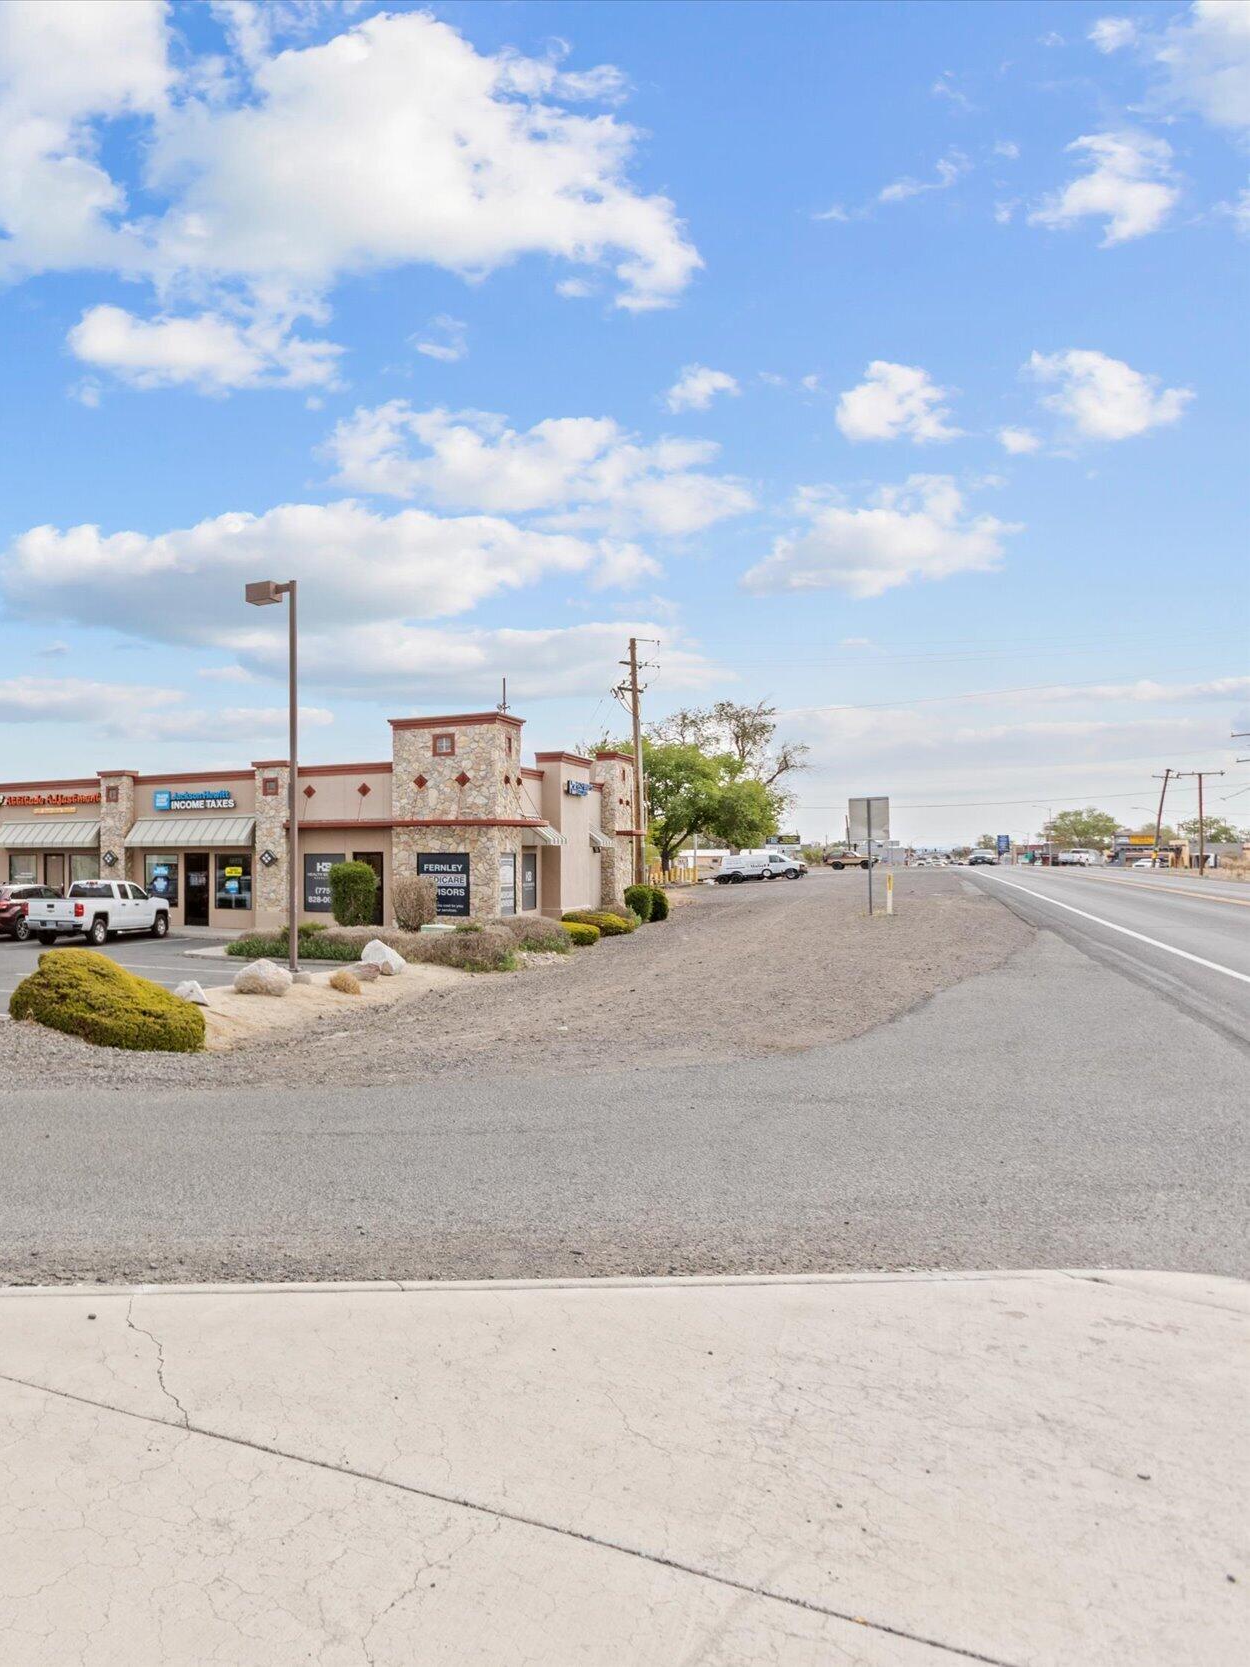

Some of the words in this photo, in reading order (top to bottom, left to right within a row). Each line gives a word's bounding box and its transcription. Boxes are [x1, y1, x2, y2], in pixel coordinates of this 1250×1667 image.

[171, 800, 205, 810] INCOME
[205, 799, 236, 809] TAXES
[423, 863, 463, 872] FERNLEY
[315, 886, 331, 895] (775
[437, 887, 466, 897] ISORS
